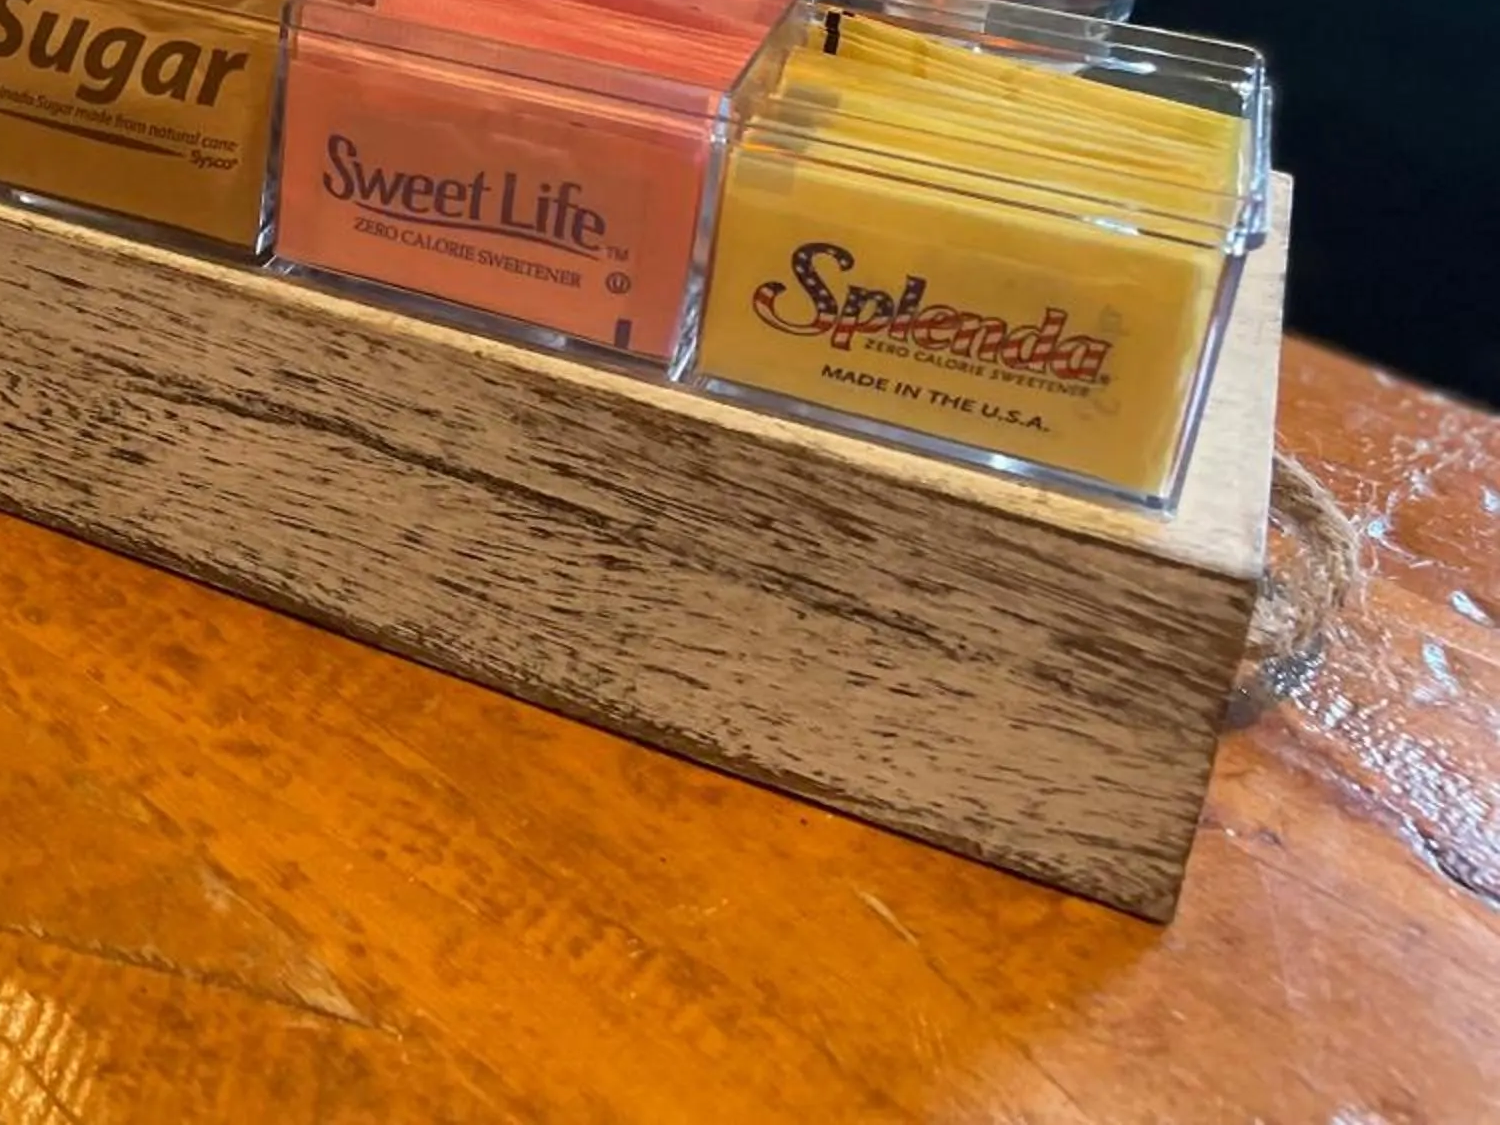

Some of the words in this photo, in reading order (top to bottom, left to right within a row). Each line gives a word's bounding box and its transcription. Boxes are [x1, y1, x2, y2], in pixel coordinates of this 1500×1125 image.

[35, 94, 75, 117] Sugar
[75, 106, 113, 127] made
[115, 112, 148, 134] from
[149, 123, 201, 145] natural
[323, 134, 491, 221] Sweet
[501, 171, 606, 252] Life
[353, 216, 399, 241] ZERO
[401, 229, 476, 261] CALORIE
[477, 249, 582, 289] SWEETENER
[752, 242, 1114, 383] Splenda
[864, 337, 911, 361] ZERO
[913, 350, 986, 378] CALORIE
[820, 363, 889, 393] MADE
[894, 380, 921, 401] IN
[927, 389, 978, 414] THE
[980, 402, 1051, 433] U.S.A.
